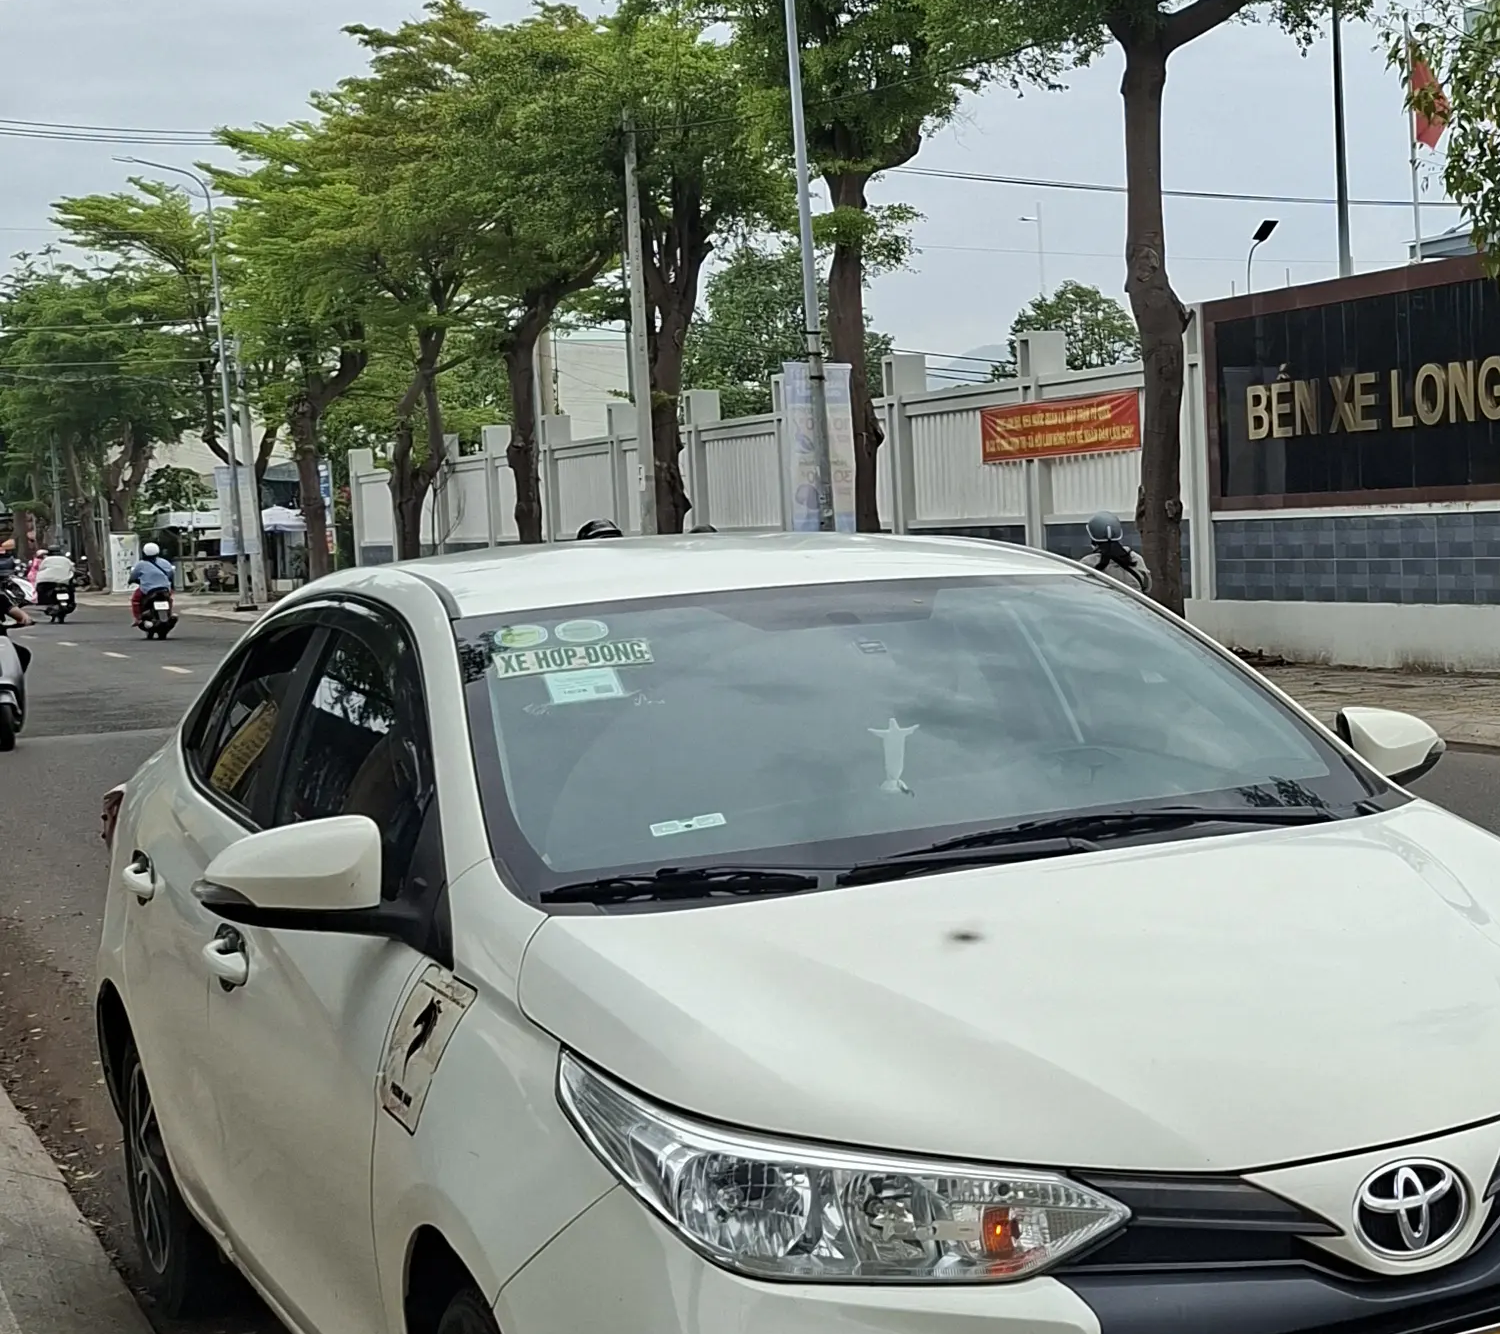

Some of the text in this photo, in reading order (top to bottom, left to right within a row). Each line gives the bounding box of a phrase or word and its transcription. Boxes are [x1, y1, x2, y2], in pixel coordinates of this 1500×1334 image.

[1246, 361, 1321, 441] BẾN
[1328, 371, 1381, 433] XE
[501, 653, 531, 674] XE
